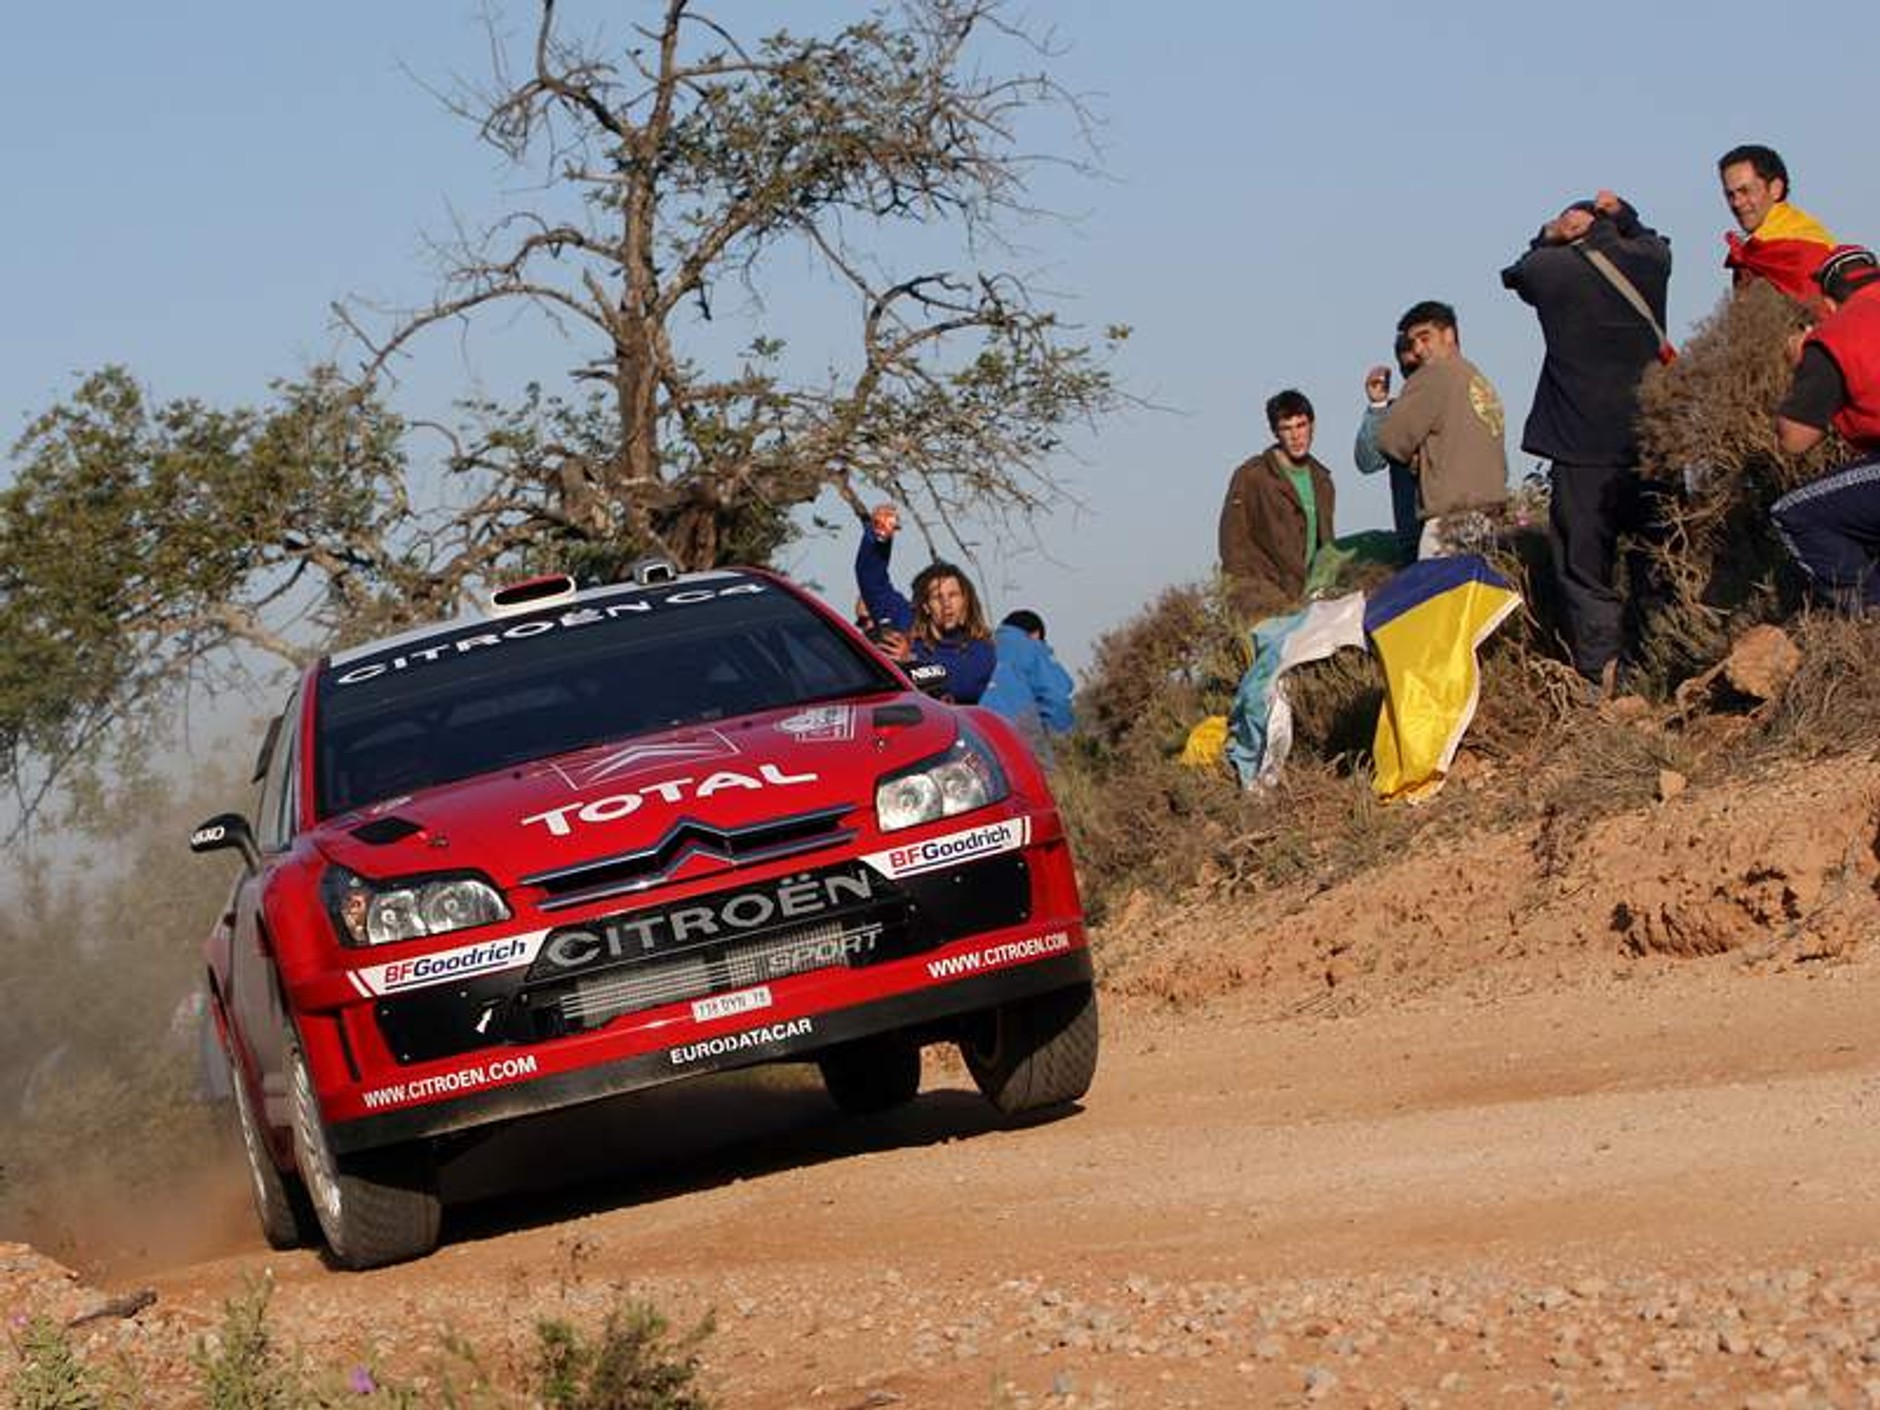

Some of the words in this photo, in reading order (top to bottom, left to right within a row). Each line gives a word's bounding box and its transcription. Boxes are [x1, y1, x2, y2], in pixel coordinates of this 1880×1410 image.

[337, 599, 652, 685] CITROËN
[521, 763, 818, 836] TOTAL
[890, 826, 1012, 868] BFGoodrich
[546, 867, 874, 968] CITROËN
[384, 938, 526, 984] BFGoodrich
[768, 927, 884, 973] SPORT
[927, 931, 1070, 978] WWW.CITROEN.COM
[671, 1017, 814, 1065] EURODATACAR
[362, 1055, 538, 1108] WWW.CITROEN.COM
